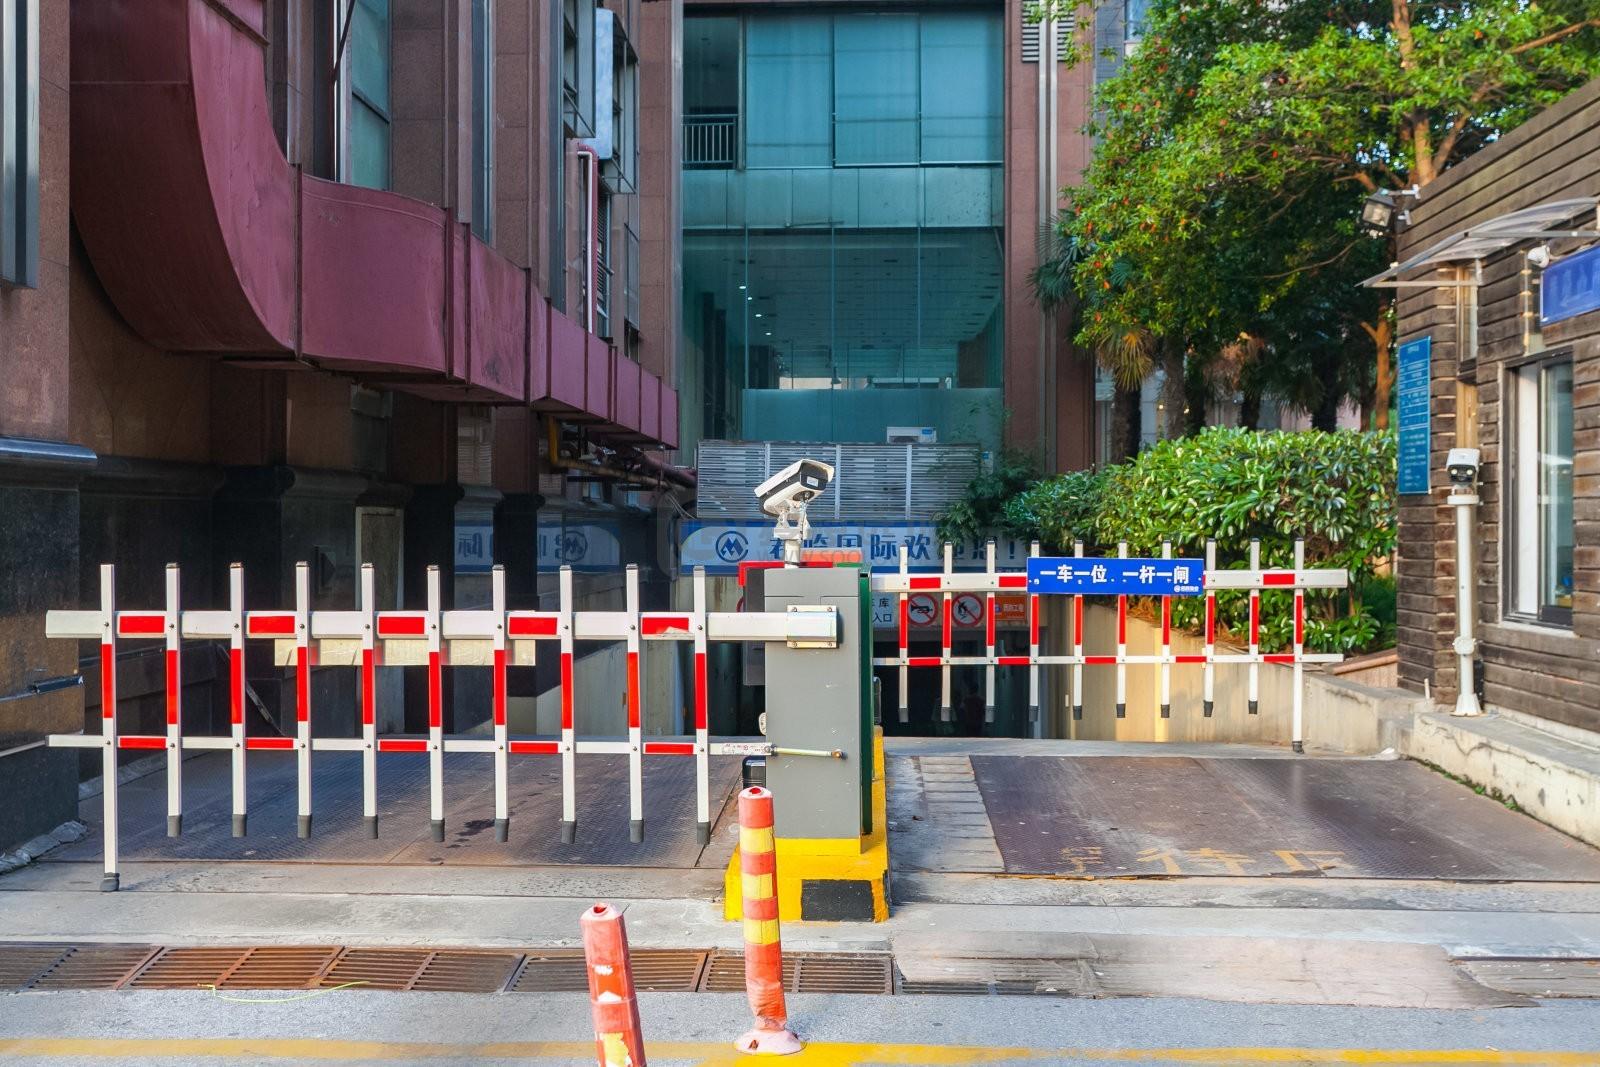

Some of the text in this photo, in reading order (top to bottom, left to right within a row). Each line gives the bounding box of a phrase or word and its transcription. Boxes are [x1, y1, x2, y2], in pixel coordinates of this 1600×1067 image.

[1040, 564, 1190, 584] 一车一位 一杆一闸
